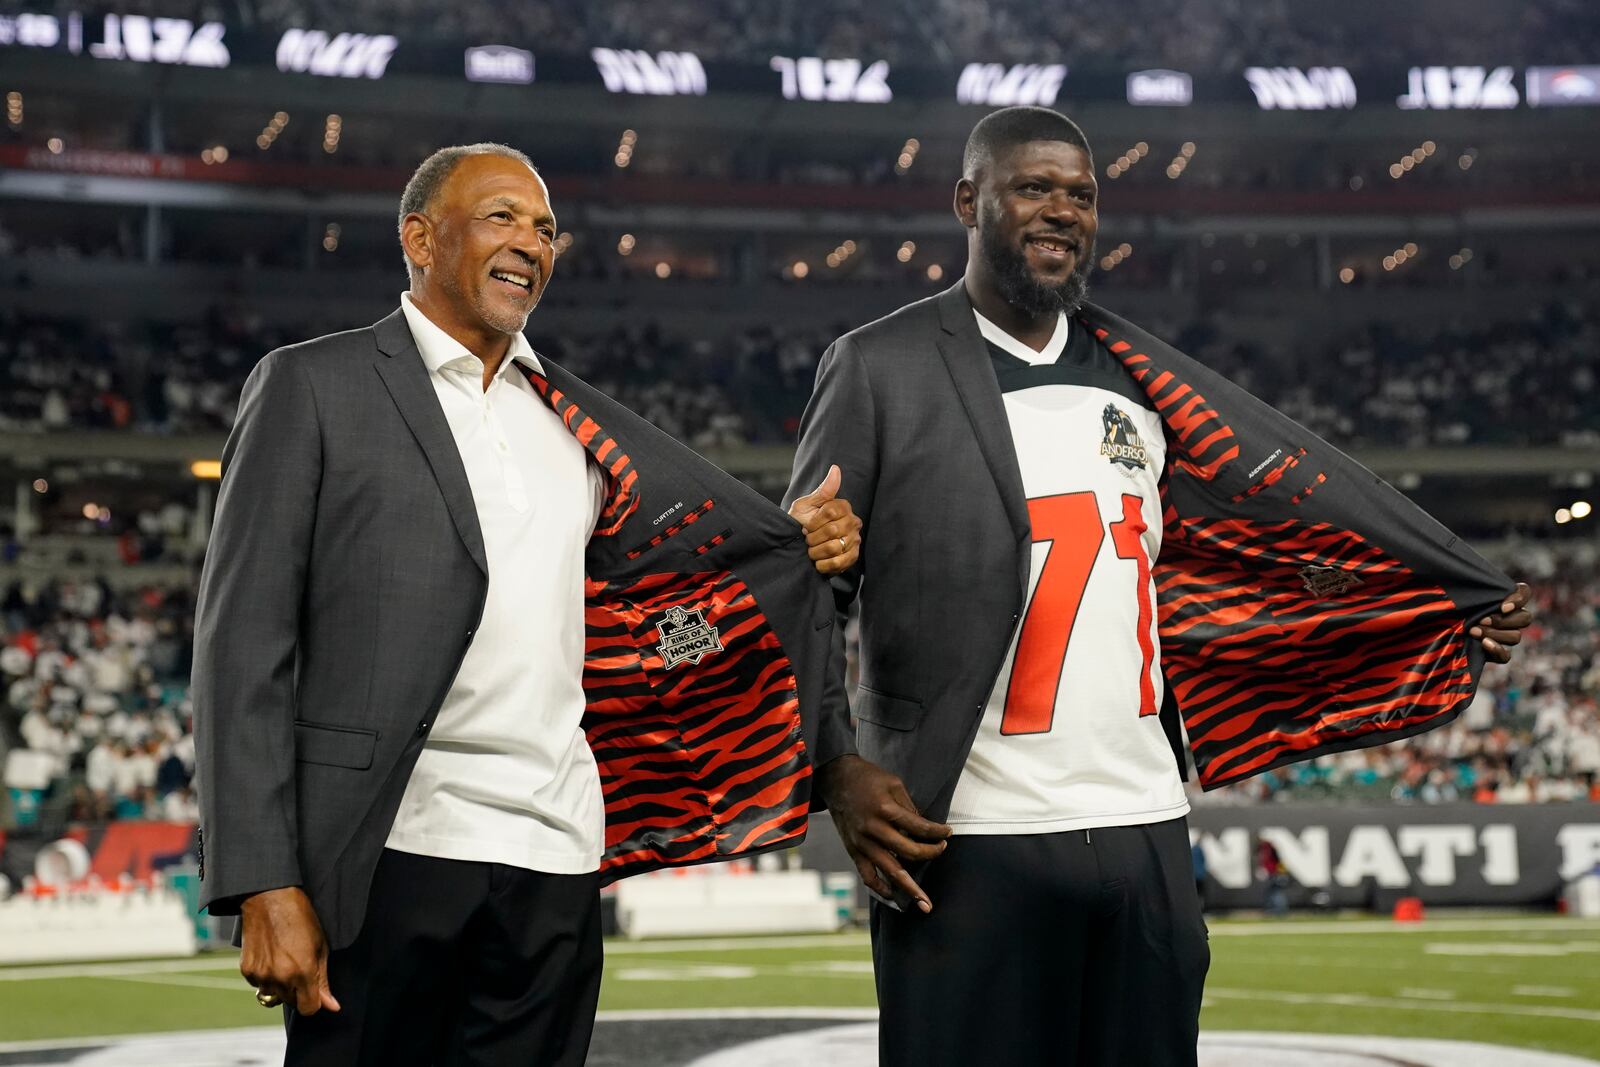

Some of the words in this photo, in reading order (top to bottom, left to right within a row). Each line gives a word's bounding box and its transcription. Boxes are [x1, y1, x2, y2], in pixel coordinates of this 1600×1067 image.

[653, 507, 675, 525] CURTIS
[1001, 490, 1157, 736] 71
[671, 633, 690, 645] RING
[691, 629, 702, 638] OF
[670, 637, 711, 659] HONOR
